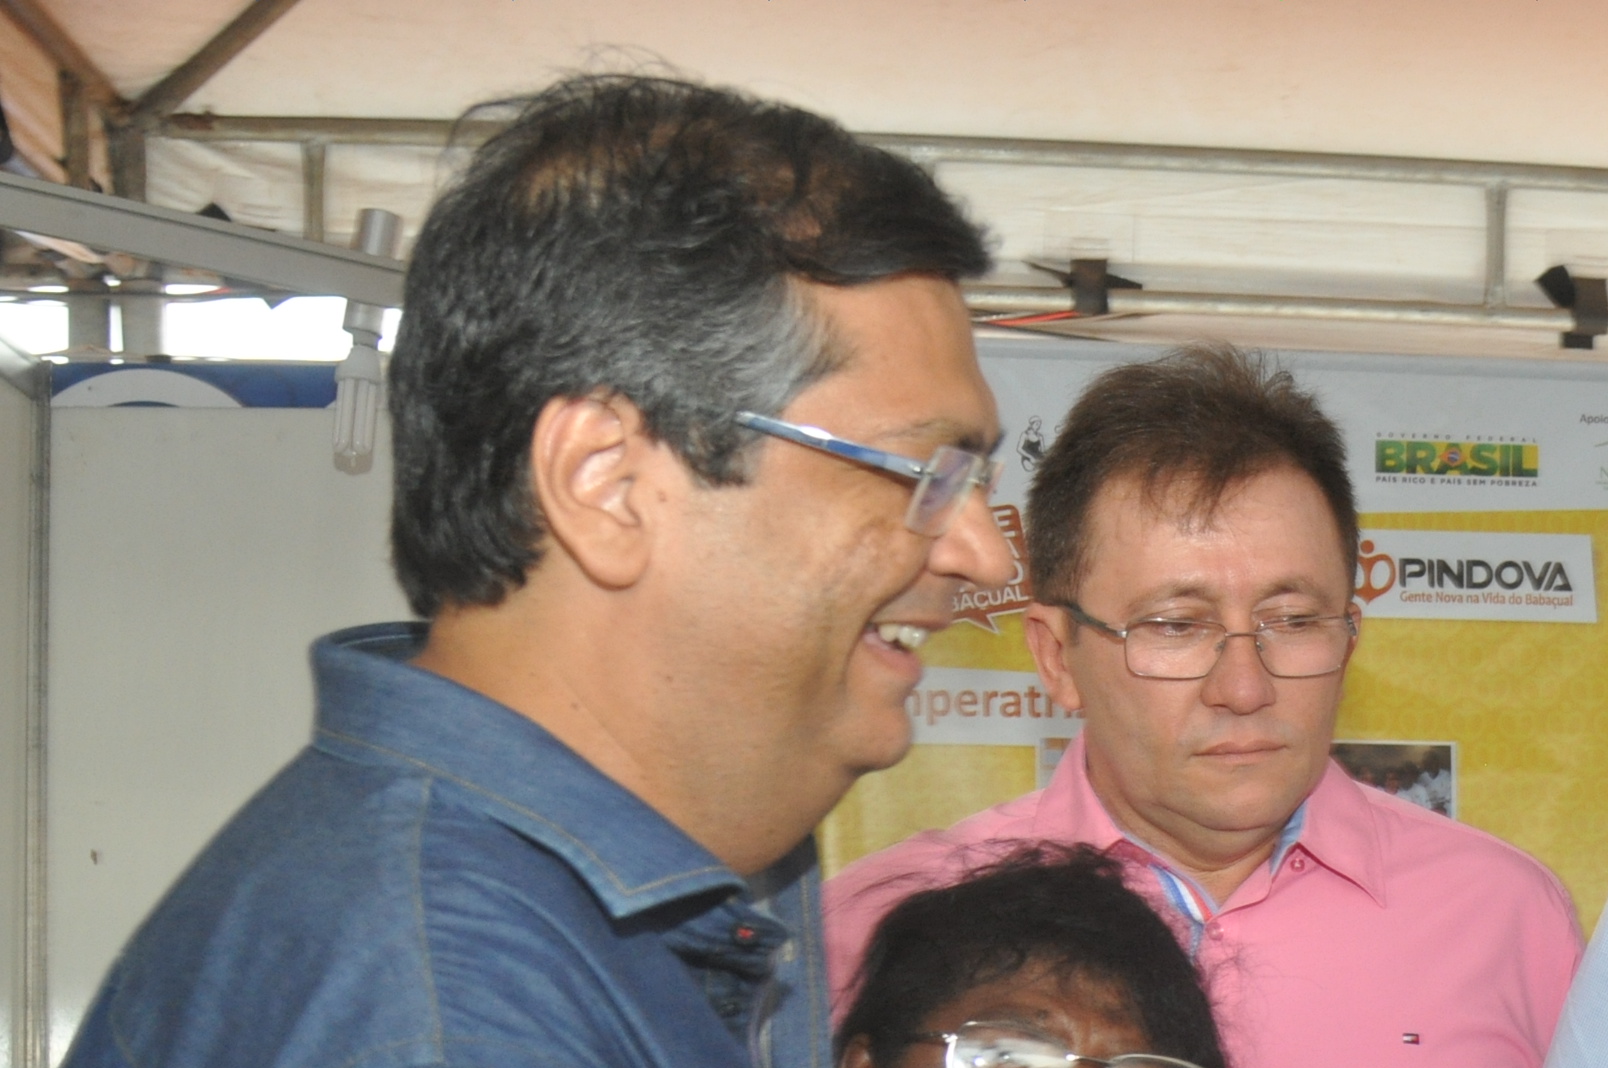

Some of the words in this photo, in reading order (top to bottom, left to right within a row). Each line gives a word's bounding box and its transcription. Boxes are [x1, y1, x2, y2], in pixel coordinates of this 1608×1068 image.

[1375, 431, 1452, 441] GOVERNO
[1466, 434, 1537, 444] FEDERAL
[1375, 439, 1539, 478] BRASIL
[1401, 476, 1426, 485] RICO
[1466, 478, 1486, 486] SEM
[1490, 479, 1538, 488] POBREZA
[1398, 557, 1573, 592] PINDOVA
[1400, 590, 1433, 603] Gente
[1436, 591, 1463, 604] Nova
[1466, 595, 1480, 604] na
[1482, 592, 1506, 605] Vida
[1509, 593, 1523, 606] do
[1526, 594, 1573, 609] Babaçual
